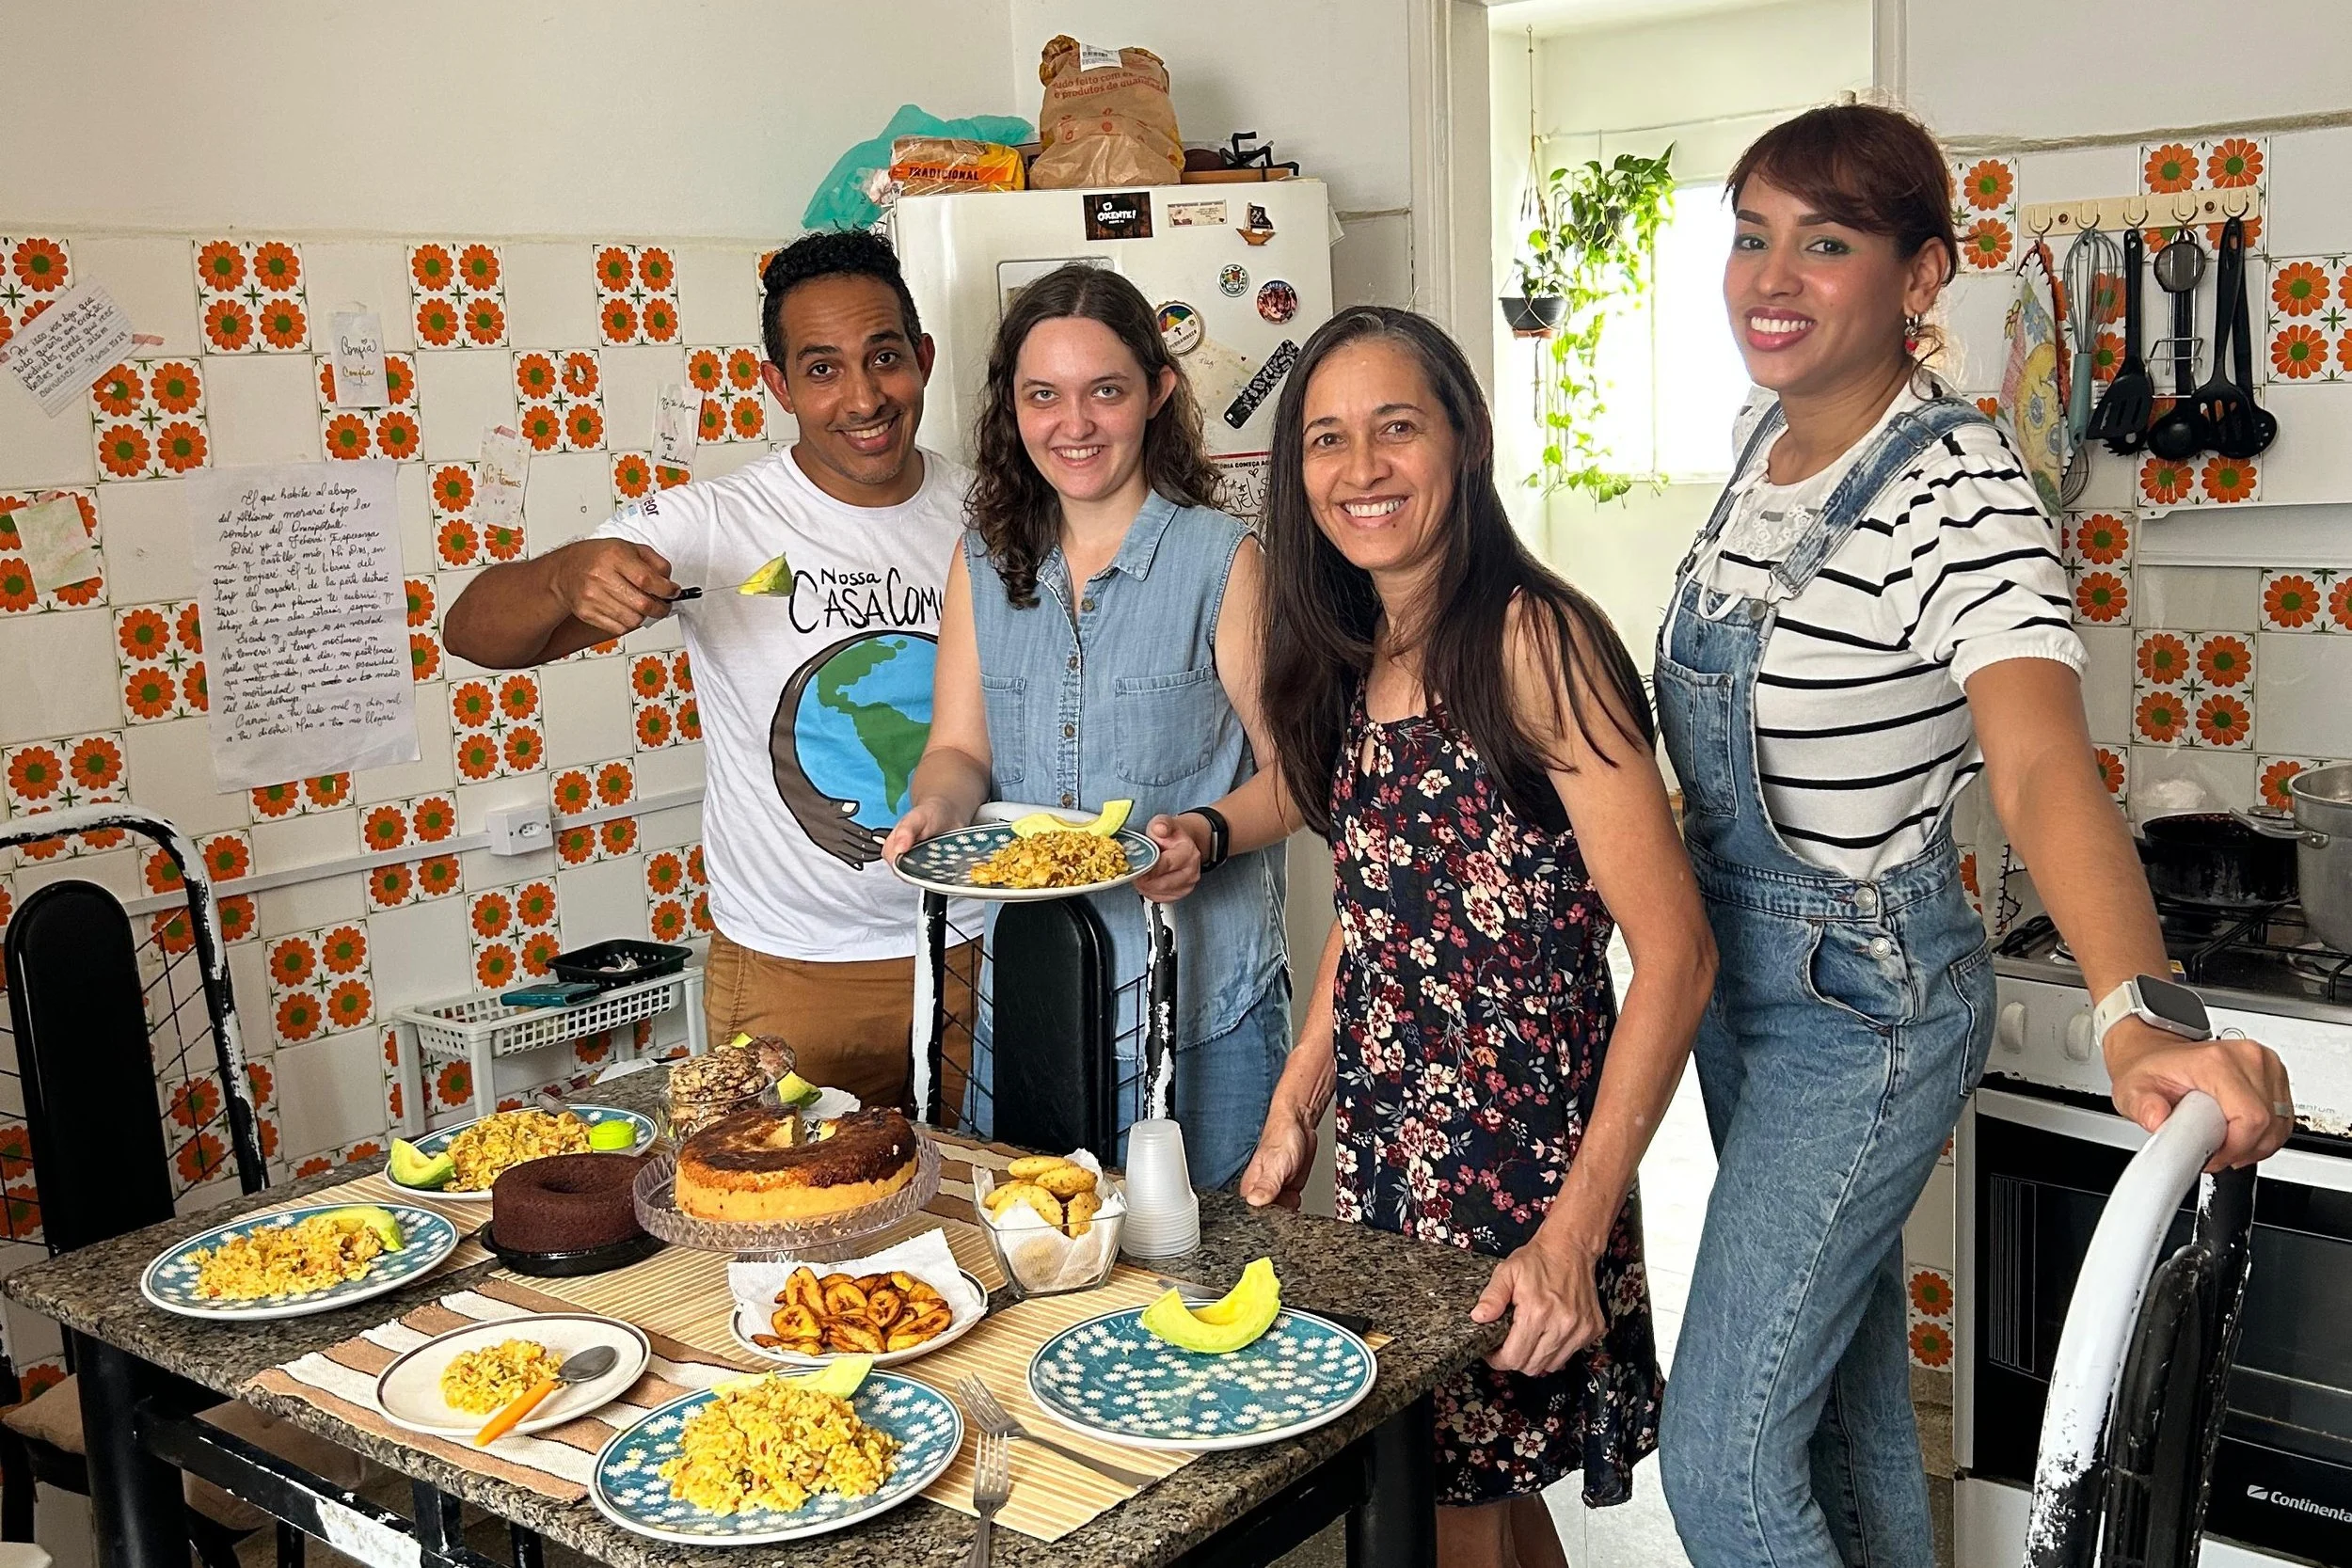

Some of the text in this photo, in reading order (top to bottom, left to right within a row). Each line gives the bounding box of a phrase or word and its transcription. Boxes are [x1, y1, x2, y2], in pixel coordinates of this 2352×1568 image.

[1075, 77, 1099, 87] feito
[1100, 72, 1120, 83] com
[1062, 87, 1104, 100] produtos
[908, 166, 979, 181] TRADICIONAL
[1097, 210, 1136, 221] OXENTE!
[62, 310, 77, 323] digo
[13, 357, 33, 373] tudo
[478, 464, 494, 487] No
[261, 495, 277, 507] que
[316, 483, 327, 497] al
[218, 515, 231, 524] del
[283, 505, 325, 519] morará
[354, 498, 371, 510] la
[219, 525, 262, 542] sombra
[269, 522, 282, 534] del
[260, 544, 272, 556] yo
[261, 552, 296, 565] castillo
[304, 565, 316, 575] te
[358, 560, 375, 569] del
[821, 567, 882, 586] Nossa
[246, 584, 259, 597] del
[308, 580, 319, 590] de
[326, 578, 336, 586] la
[328, 592, 338, 602] te
[788, 567, 943, 633] CASA COM
[249, 616, 259, 626] de
[287, 611, 304, 622] alas
[333, 623, 346, 631] su
[253, 661, 268, 674] que
[302, 655, 312, 663] de
[224, 677, 238, 692] que
[242, 681, 295, 698] mortandad
[301, 681, 316, 692] que
[223, 705, 237, 714] del
[245, 700, 261, 711] día
[288, 707, 303, 717] tu
[307, 704, 326, 715] lado
[331, 700, 350, 711] mil
[353, 701, 361, 712] y
[366, 696, 385, 708] diez
[238, 729, 251, 740] tu
[2296, 1103, 2335, 1114] antum
[2270, 1491, 2352, 1522] Continenta
